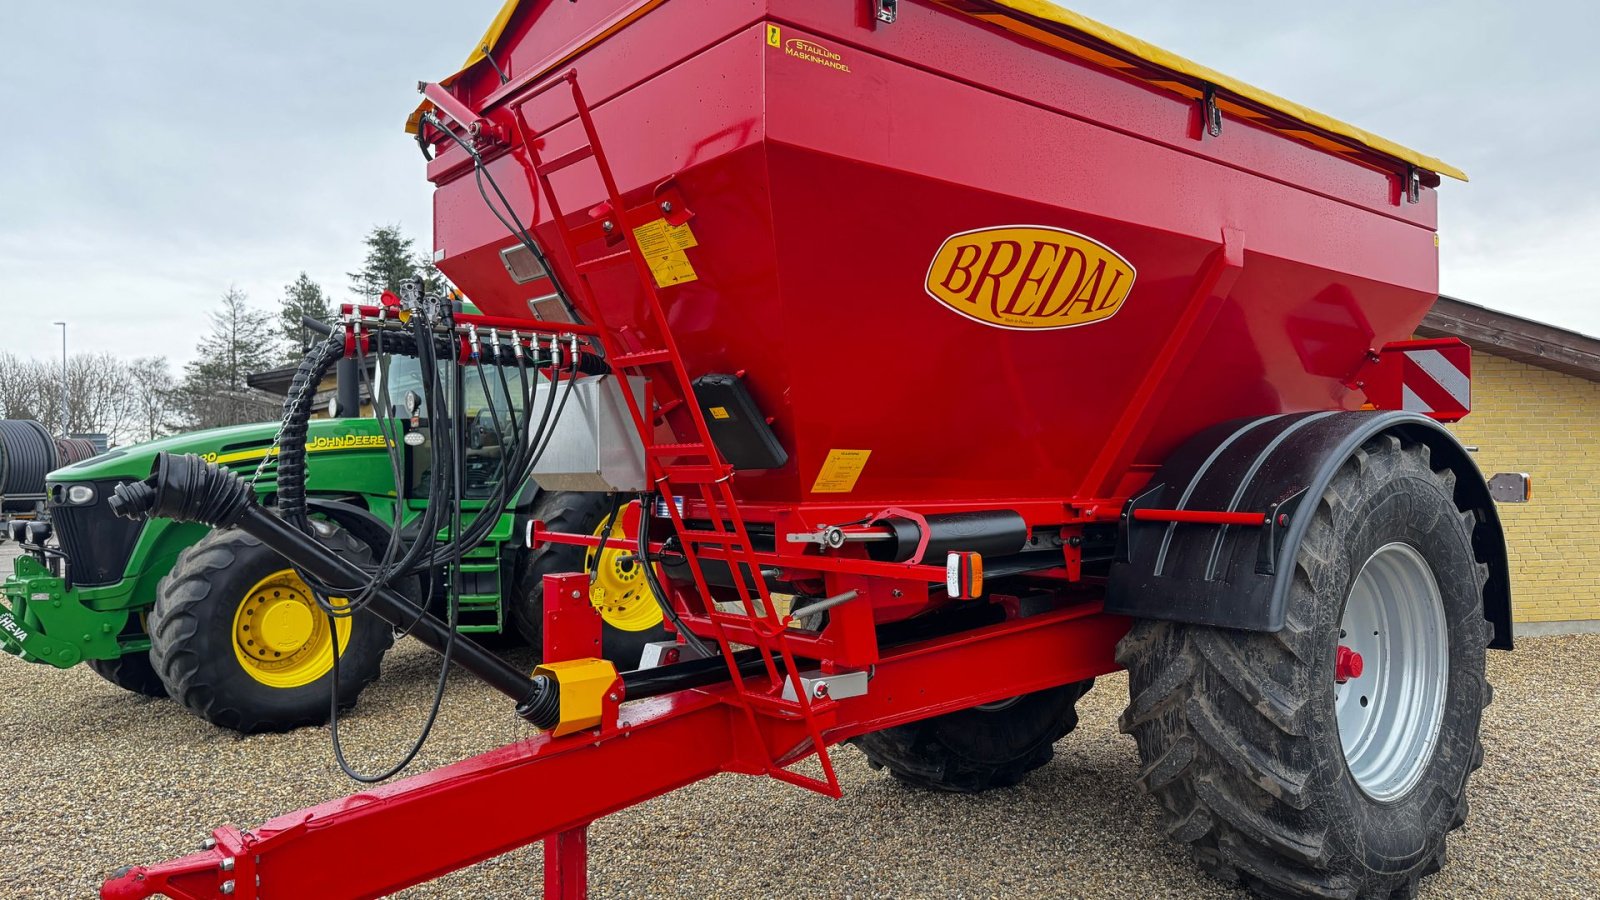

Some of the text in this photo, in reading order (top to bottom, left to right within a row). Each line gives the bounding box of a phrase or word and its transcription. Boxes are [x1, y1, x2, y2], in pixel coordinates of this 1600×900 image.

[785, 47, 851, 73] MASKINHANDEL
[796, 41, 841, 61] STAULUND
[940, 240, 1124, 318] BREDAL
[311, 434, 385, 448] JOHN DEERE
[0, 616, 28, 642] HE-VA
